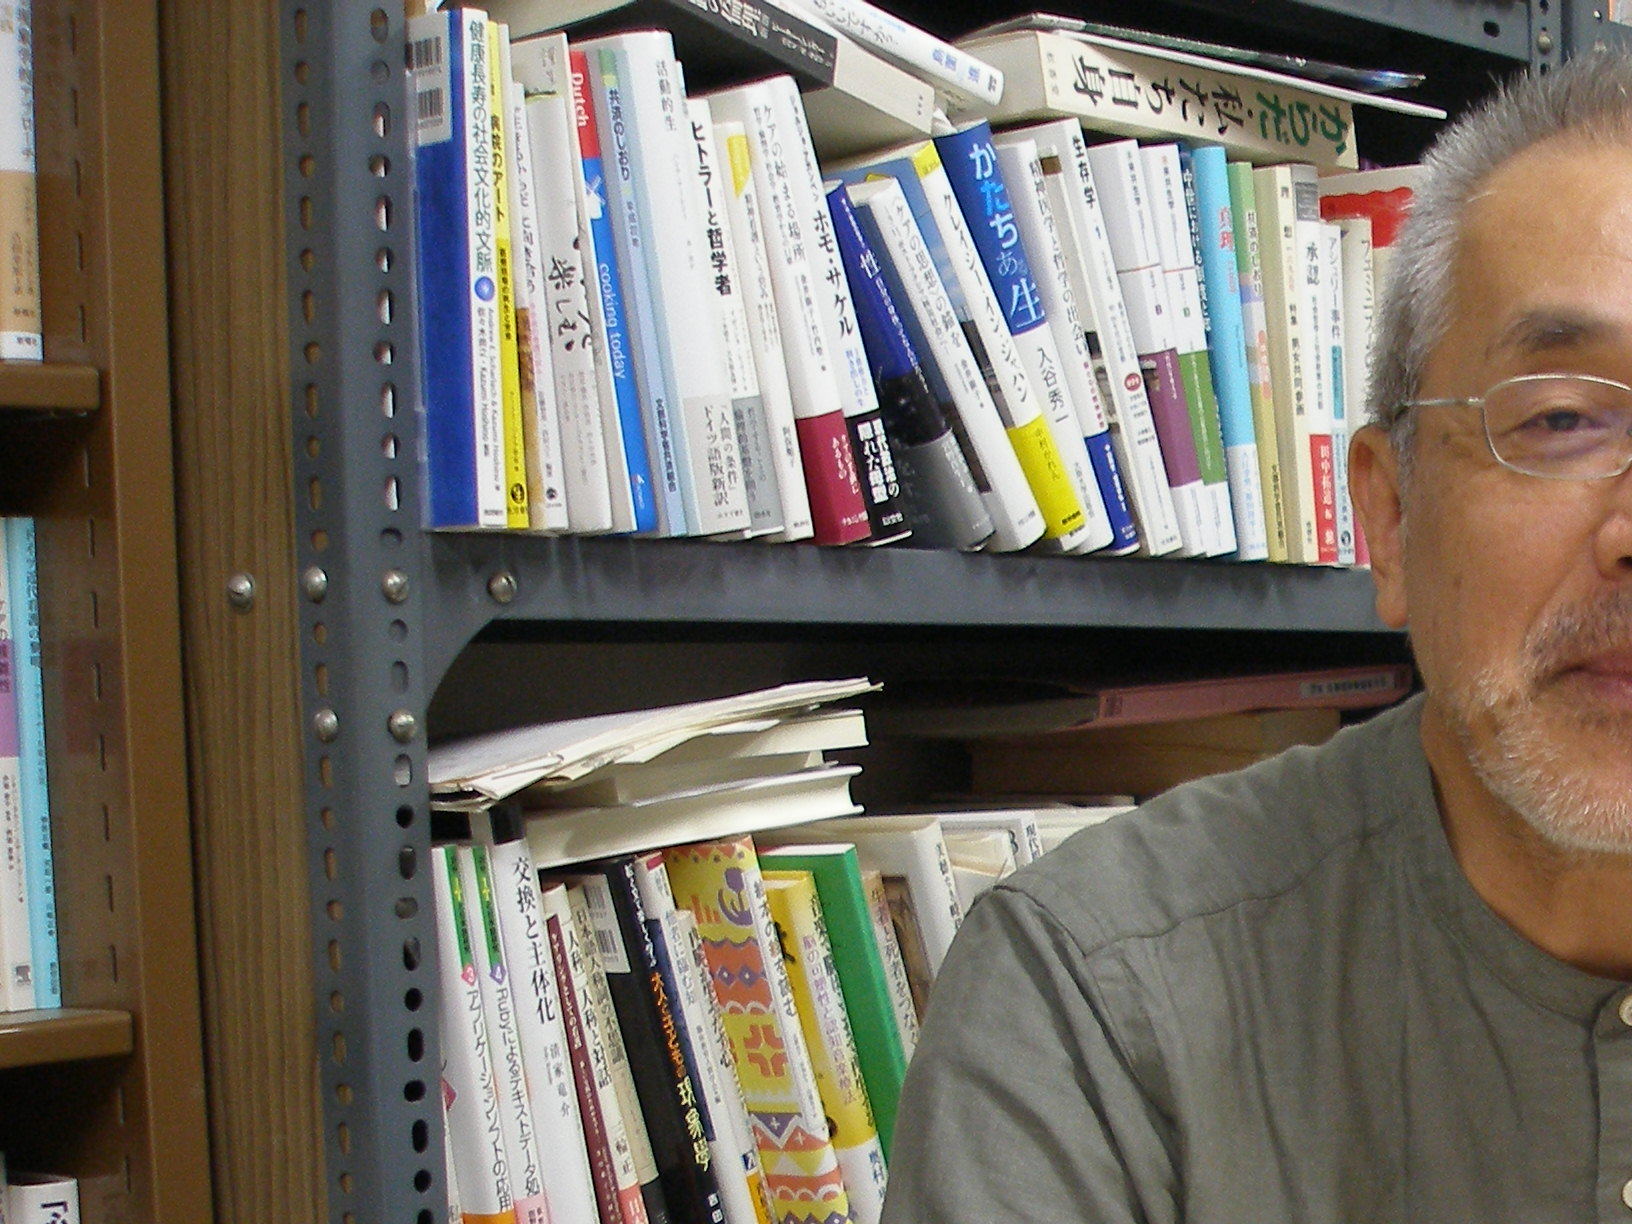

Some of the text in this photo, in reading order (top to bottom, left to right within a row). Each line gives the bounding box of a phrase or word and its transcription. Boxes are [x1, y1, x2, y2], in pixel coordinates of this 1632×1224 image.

[571, 72, 589, 128] Dutch
[1071, 54, 1348, 155] からだ・私たち自身
[691, 121, 731, 297] ヒトラーと哲学者
[969, 142, 1045, 328] かたちある生
[599, 262, 627, 380] cooking today
[812, 210, 854, 339] ホモ・サケル
[704, 406, 729, 507] ドイツ語版新訳
[513, 857, 556, 1025] 交換と主体化
